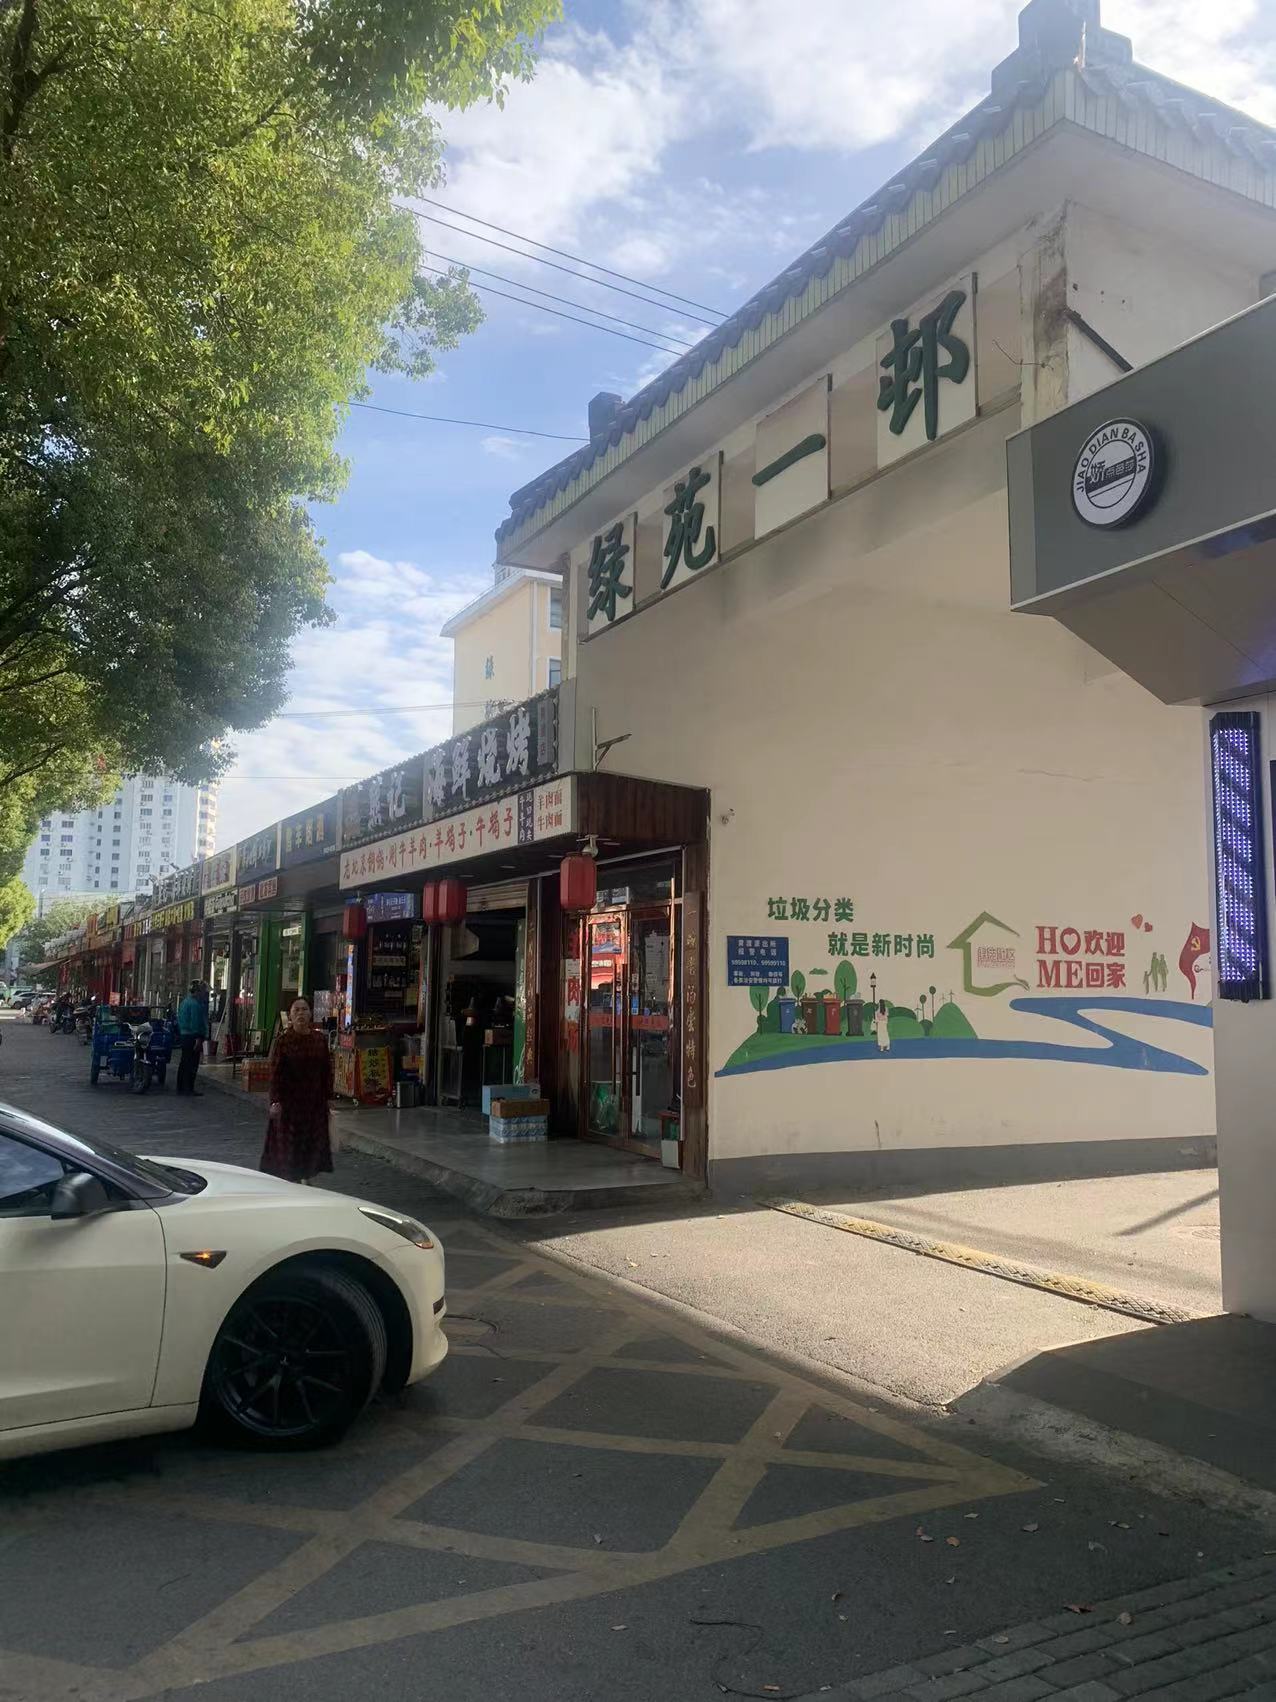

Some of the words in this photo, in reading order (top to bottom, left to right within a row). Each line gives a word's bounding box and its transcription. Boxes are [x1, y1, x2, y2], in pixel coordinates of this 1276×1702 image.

[1076, 457, 1089, 493] JIAO
[1089, 427, 1119, 455] DIAN
[1121, 427, 1137, 444] BA
[1135, 441, 1147, 474] SHA
[767, 896, 855, 923] 垃圾分类
[827, 931, 935, 959] 就是新时尚
[1084, 929, 1126, 957] 欢迎
[1085, 962, 1126, 989] 回家
